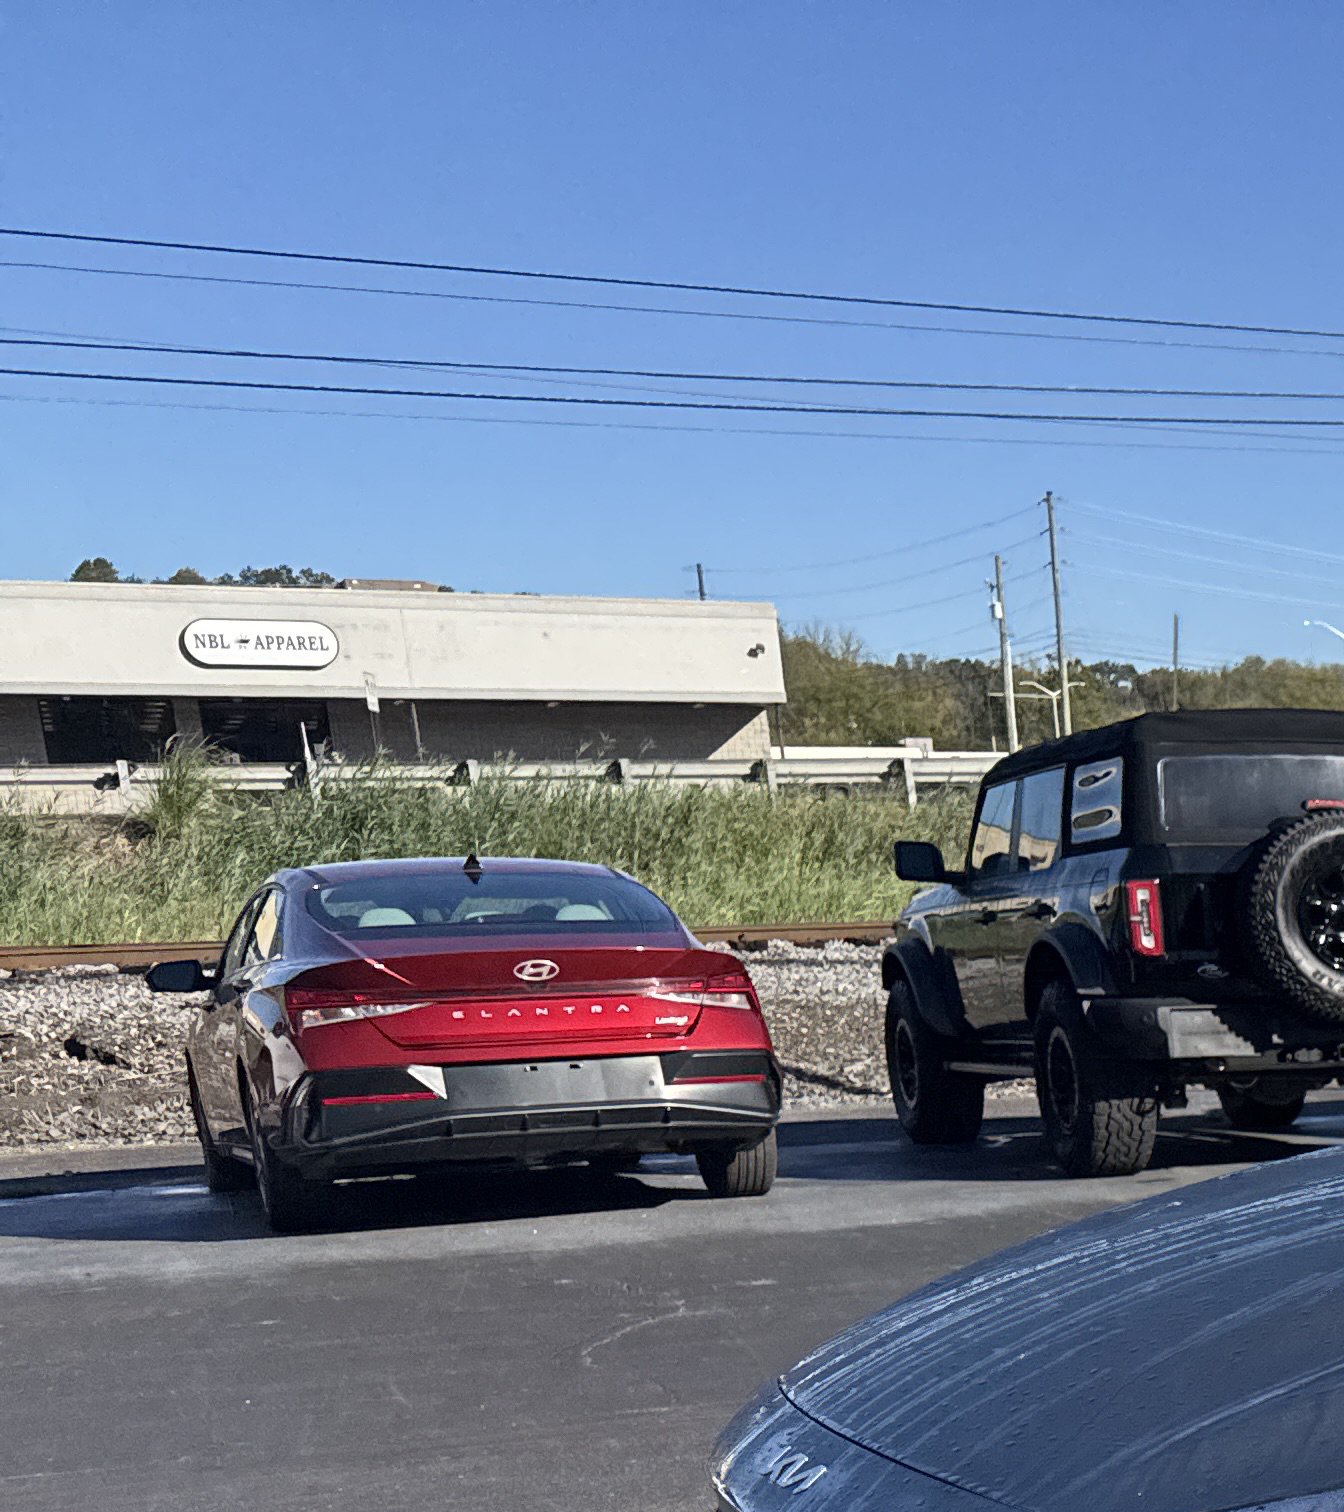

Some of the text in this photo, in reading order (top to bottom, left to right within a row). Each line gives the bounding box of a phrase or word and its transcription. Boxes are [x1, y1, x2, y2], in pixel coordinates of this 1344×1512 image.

[193, 633, 330, 651] NBL APPAREL
[452, 1003, 630, 1019] ELANTRA
[759, 1445, 828, 1496] KIA
